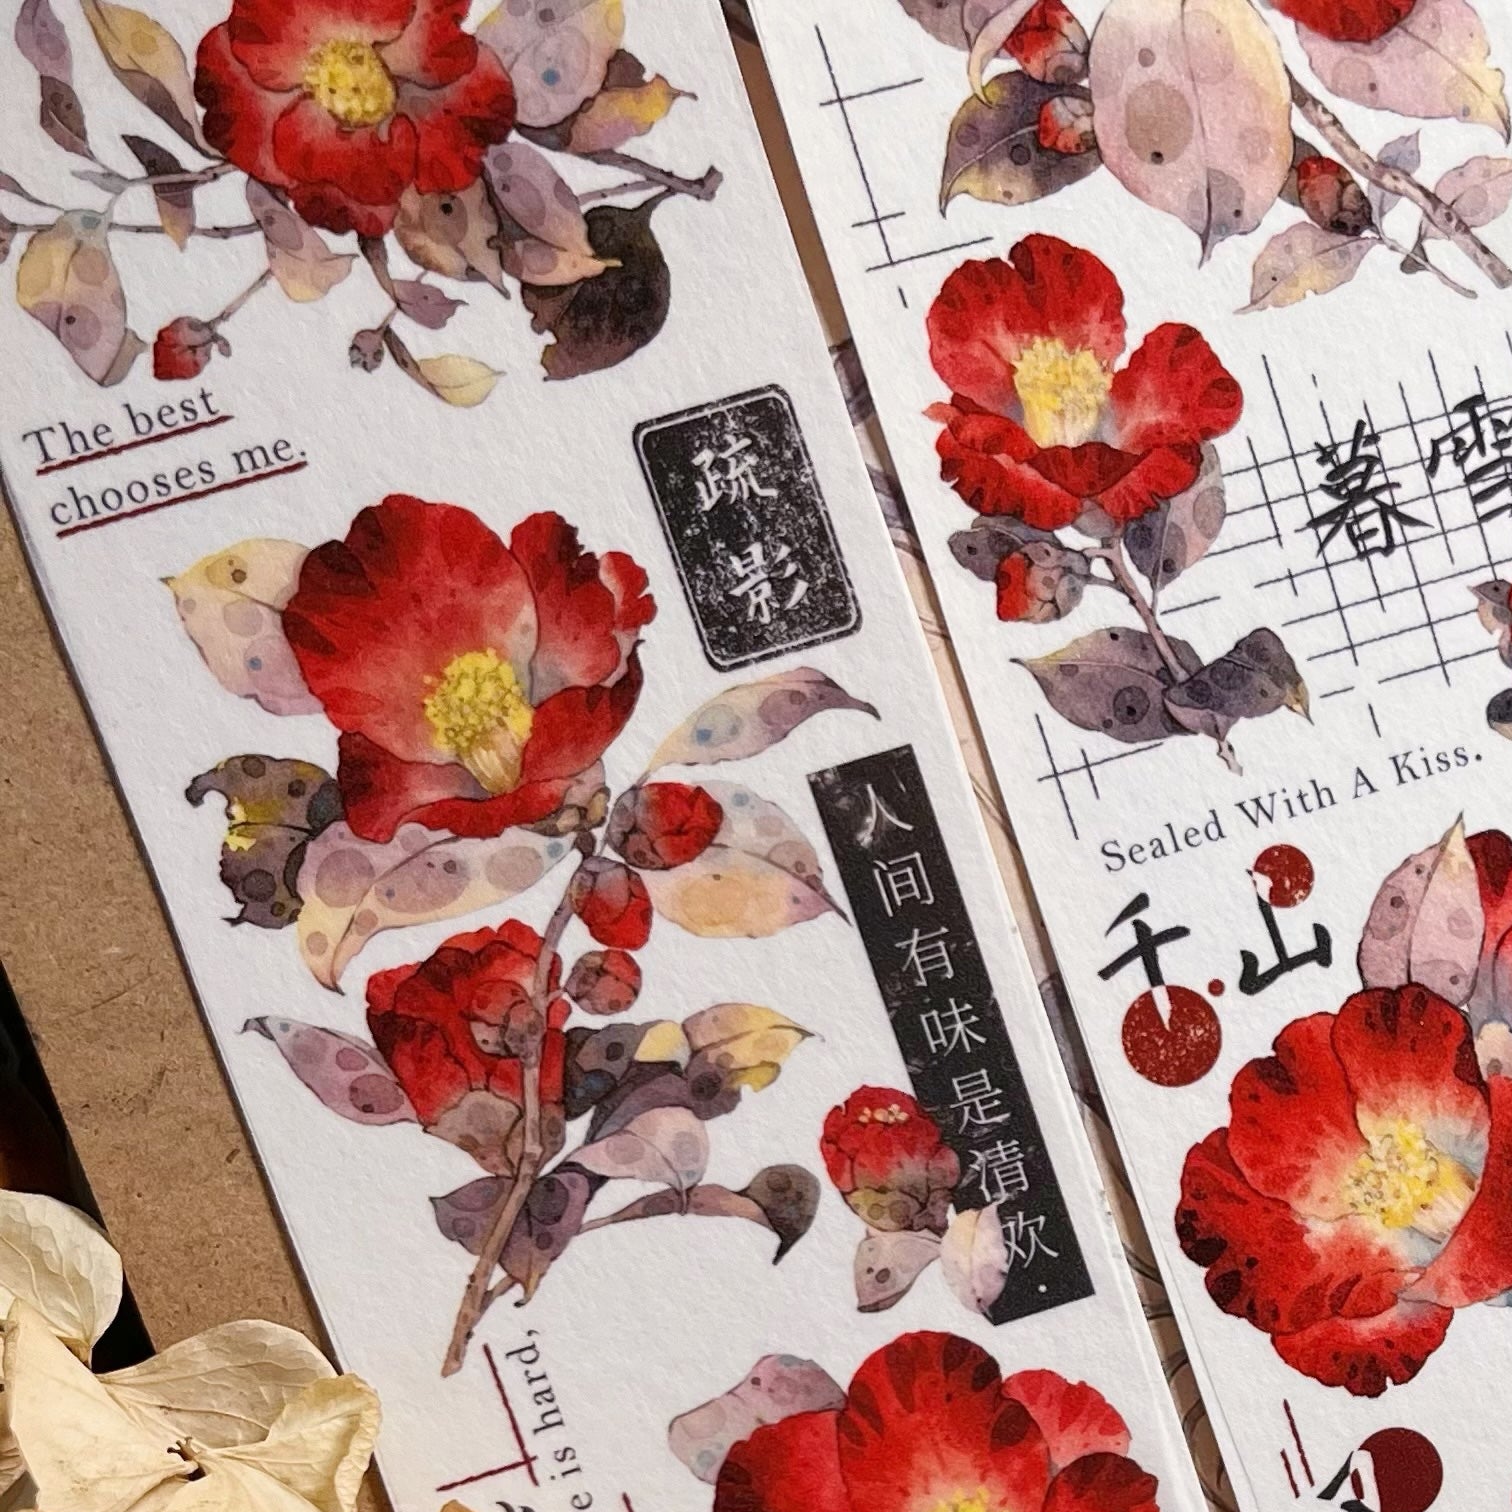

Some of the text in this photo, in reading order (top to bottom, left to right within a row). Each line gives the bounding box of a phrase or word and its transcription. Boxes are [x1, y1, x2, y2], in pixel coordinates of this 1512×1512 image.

[22, 387, 220, 465] The best
[51, 438, 308, 526] chooses me.
[1100, 744, 1483, 873] Sealed With A Kiss.
[505, 1328, 566, 1435] hard,
[549, 1446, 582, 1481] is
